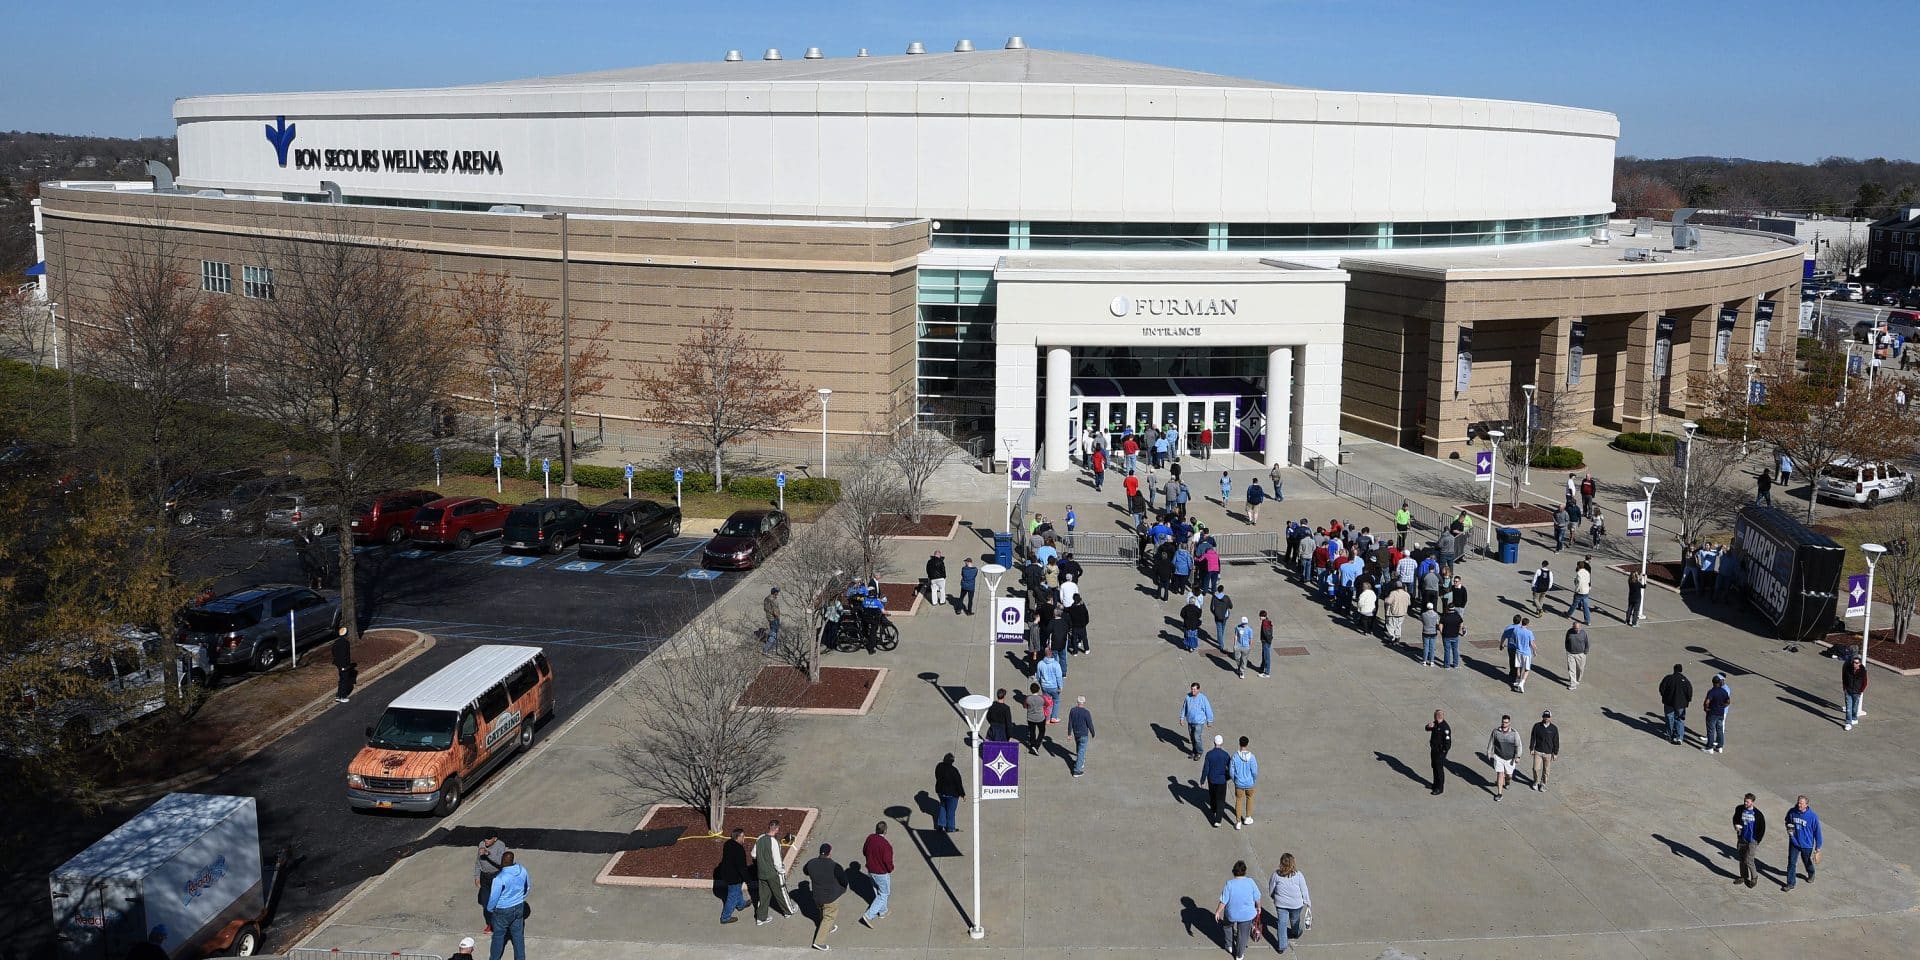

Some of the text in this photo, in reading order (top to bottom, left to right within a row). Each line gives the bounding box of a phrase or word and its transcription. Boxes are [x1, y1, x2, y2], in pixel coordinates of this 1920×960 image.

[295, 149, 503, 173] BON SECOURS WELLNESS ARENA
[1135, 298, 1239, 316] FURMAN
[1142, 327, 1202, 337] ENTRANCE
[1742, 526, 1777, 571] MARCH
[487, 713, 520, 745] CATERING
